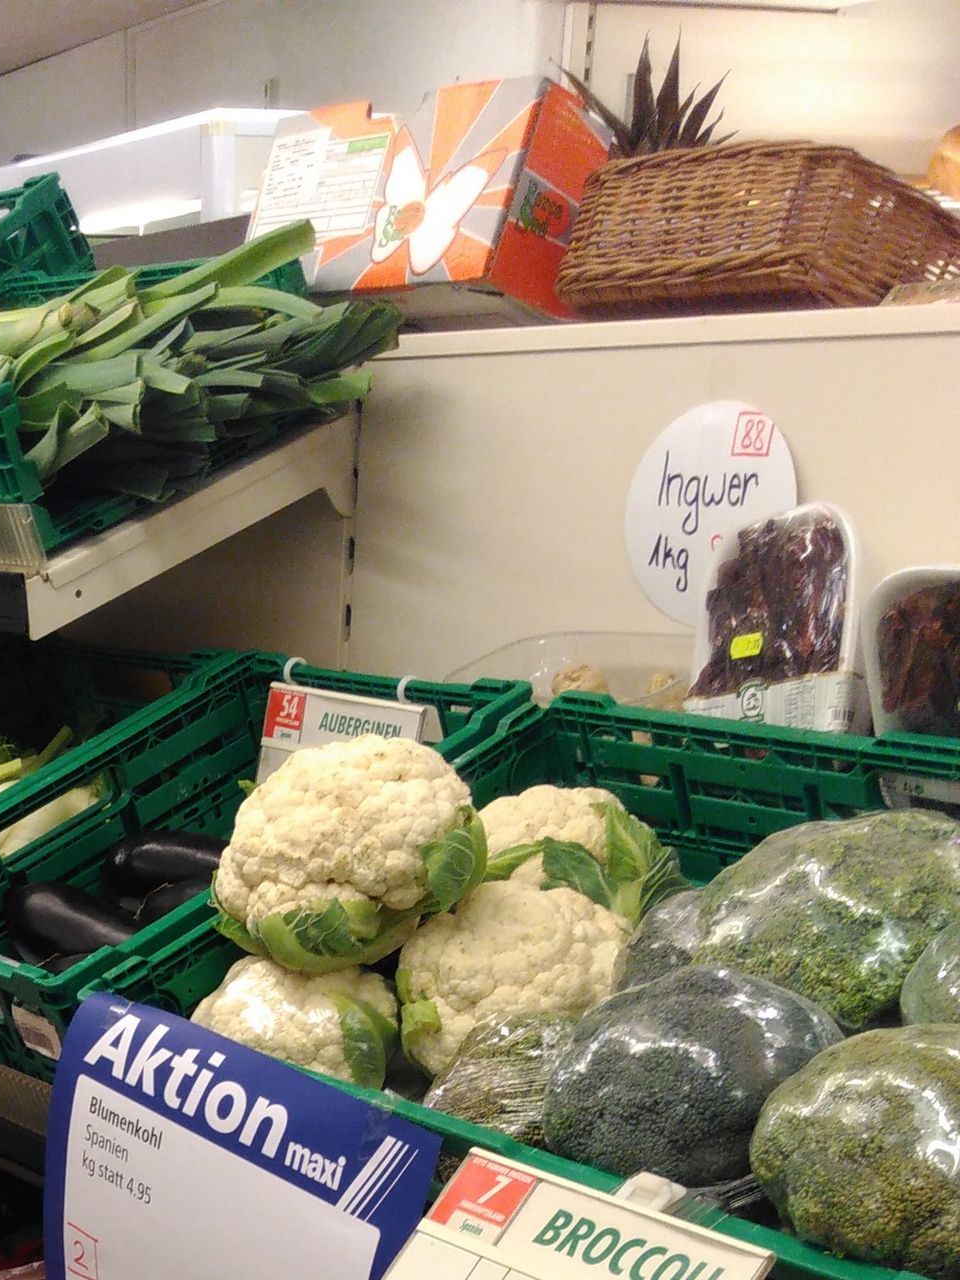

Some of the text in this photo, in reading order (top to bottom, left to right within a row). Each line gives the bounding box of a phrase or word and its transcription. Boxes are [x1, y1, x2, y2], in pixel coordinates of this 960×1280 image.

[741, 419, 766, 451] 88
[657, 450, 760, 536] Ingwer
[648, 533, 690, 593] 1kg
[279, 694, 300, 720] 54
[317, 711, 403, 739] AUBERGINEN
[83, 1013, 347, 1193] Aktion maxi
[84, 1123, 130, 1163] Spanien
[88, 1096, 164, 1151] Blumenkohl
[81, 1153, 153, 1207] kg statt 4.95
[476, 1175, 513, 1206] 7
[72, 1239, 90, 1272] 2
